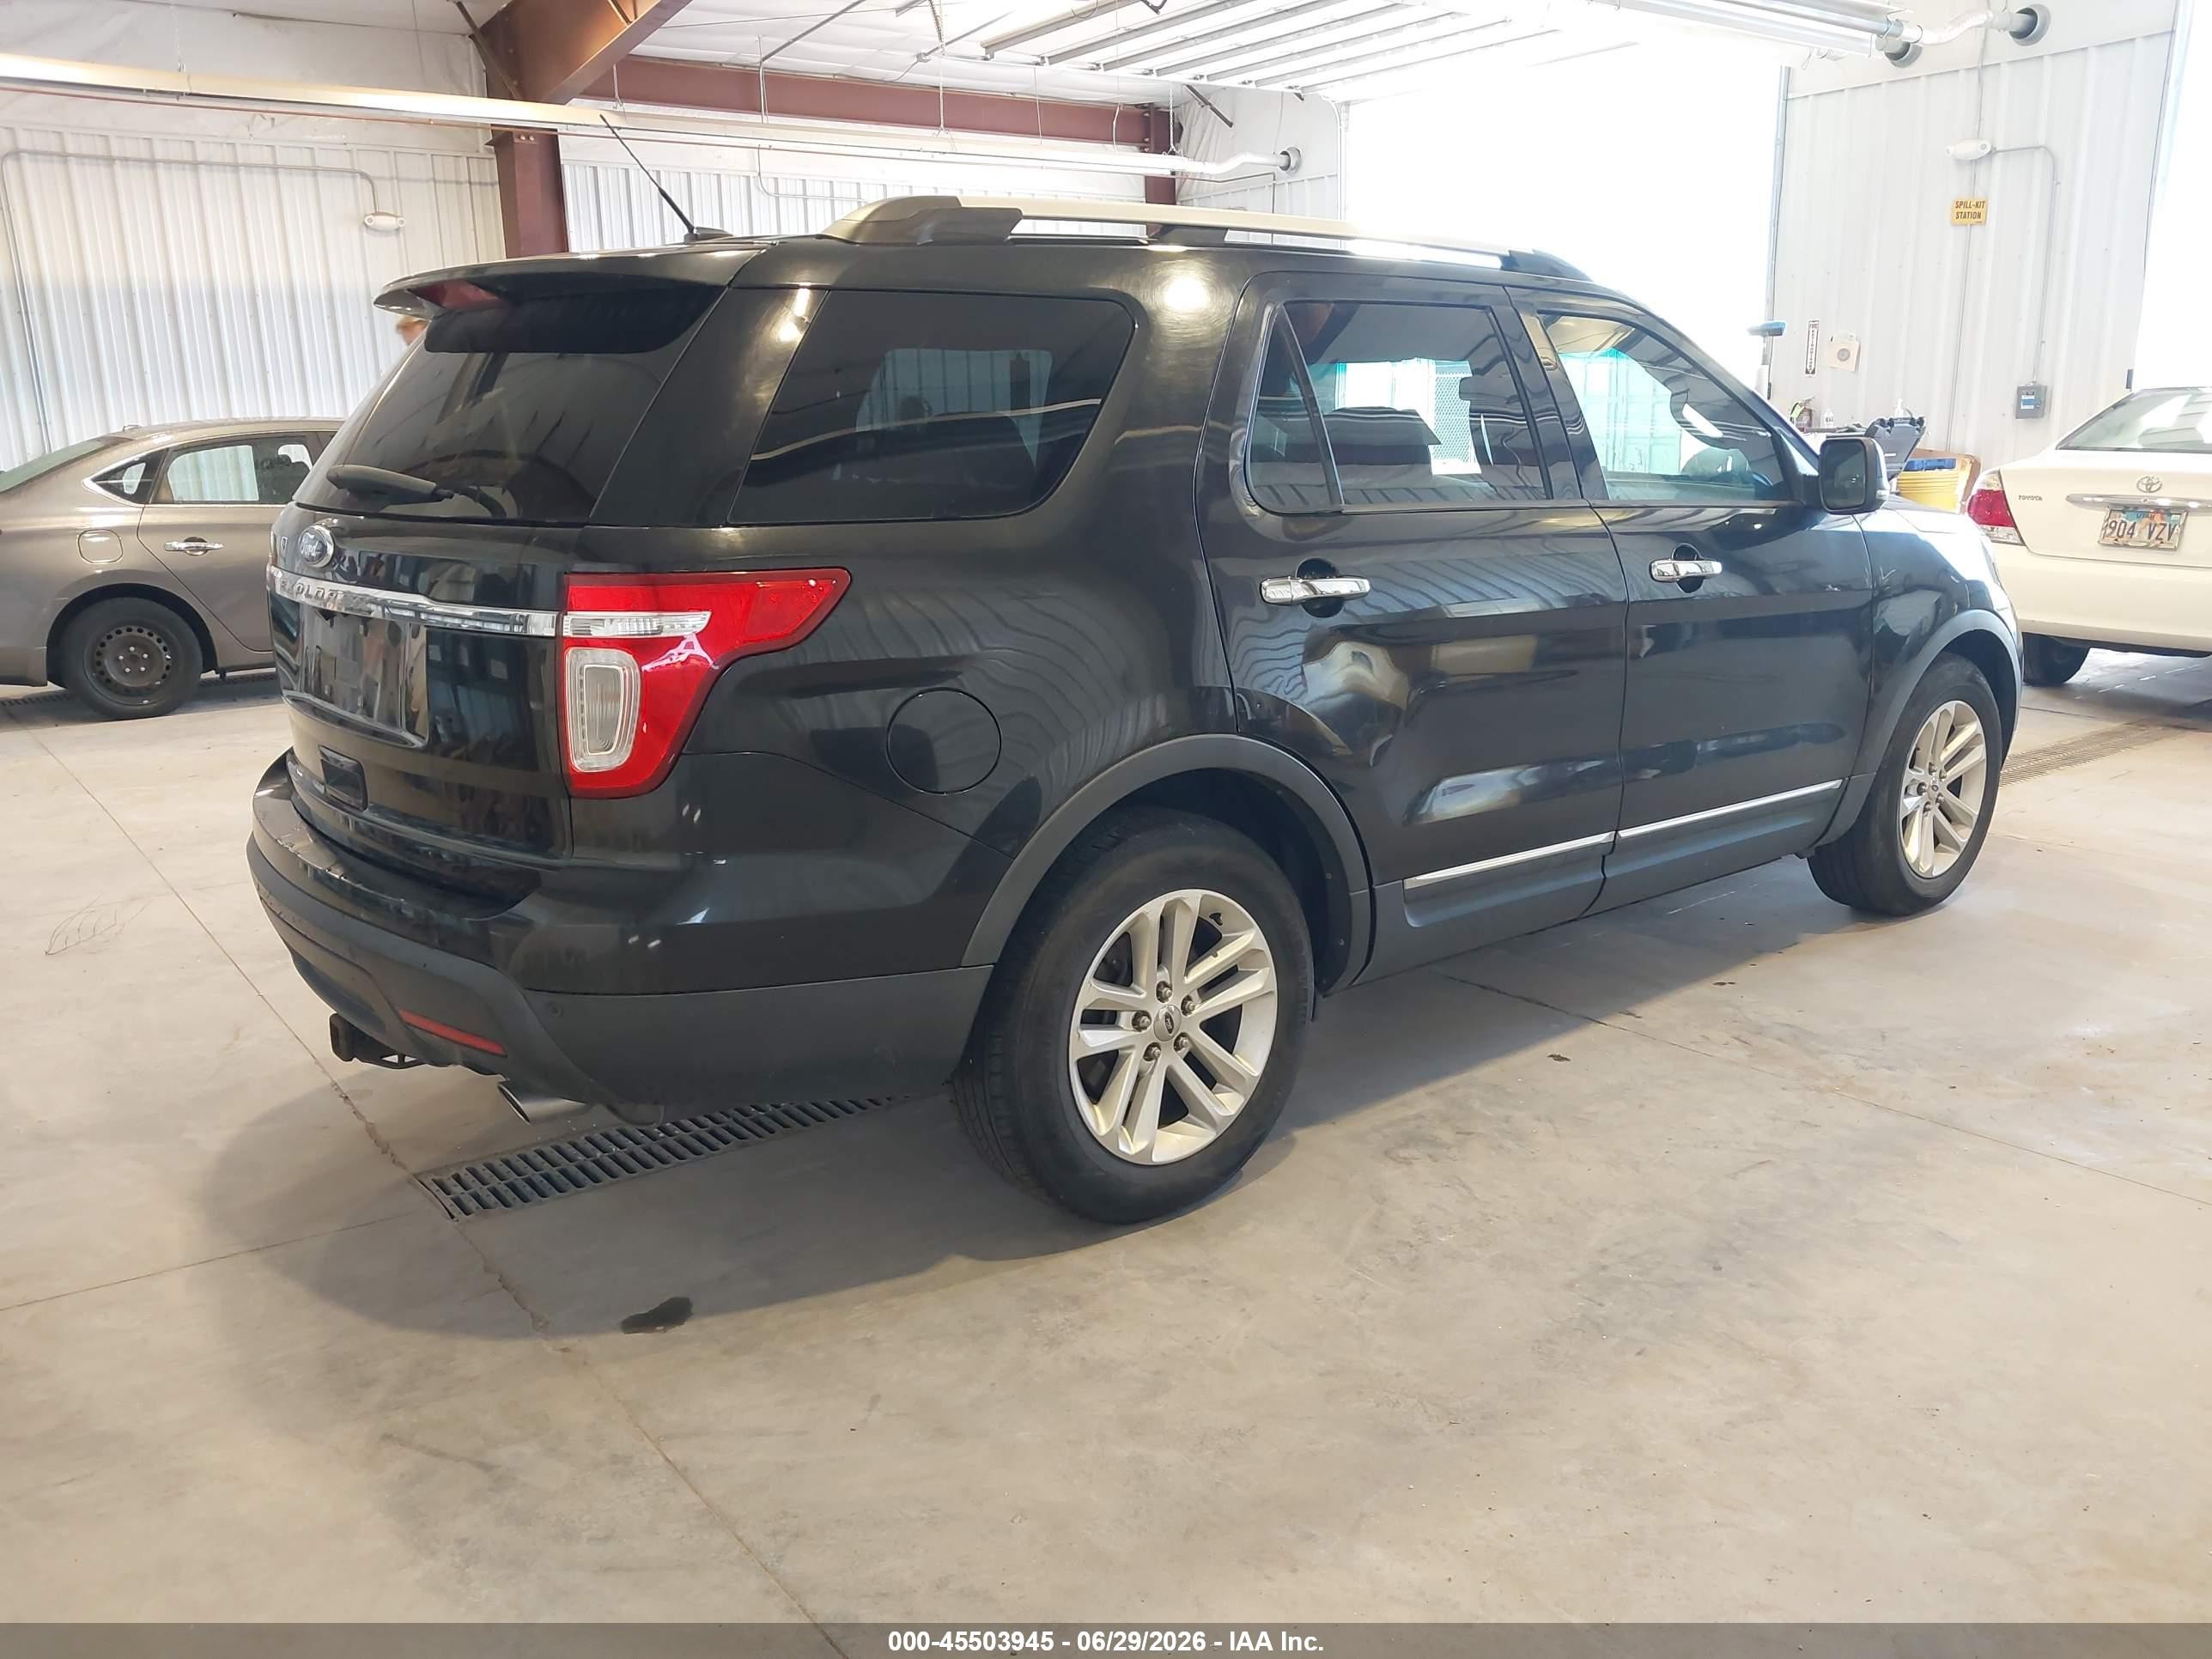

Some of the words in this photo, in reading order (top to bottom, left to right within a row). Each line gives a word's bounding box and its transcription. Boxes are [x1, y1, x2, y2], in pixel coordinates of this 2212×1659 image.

[1955, 200, 1985, 209] SPILL-KIT
[2107, 520, 2137, 539] 904
[2147, 522, 2178, 541] VZV
[301, 532, 321, 557] Ford
